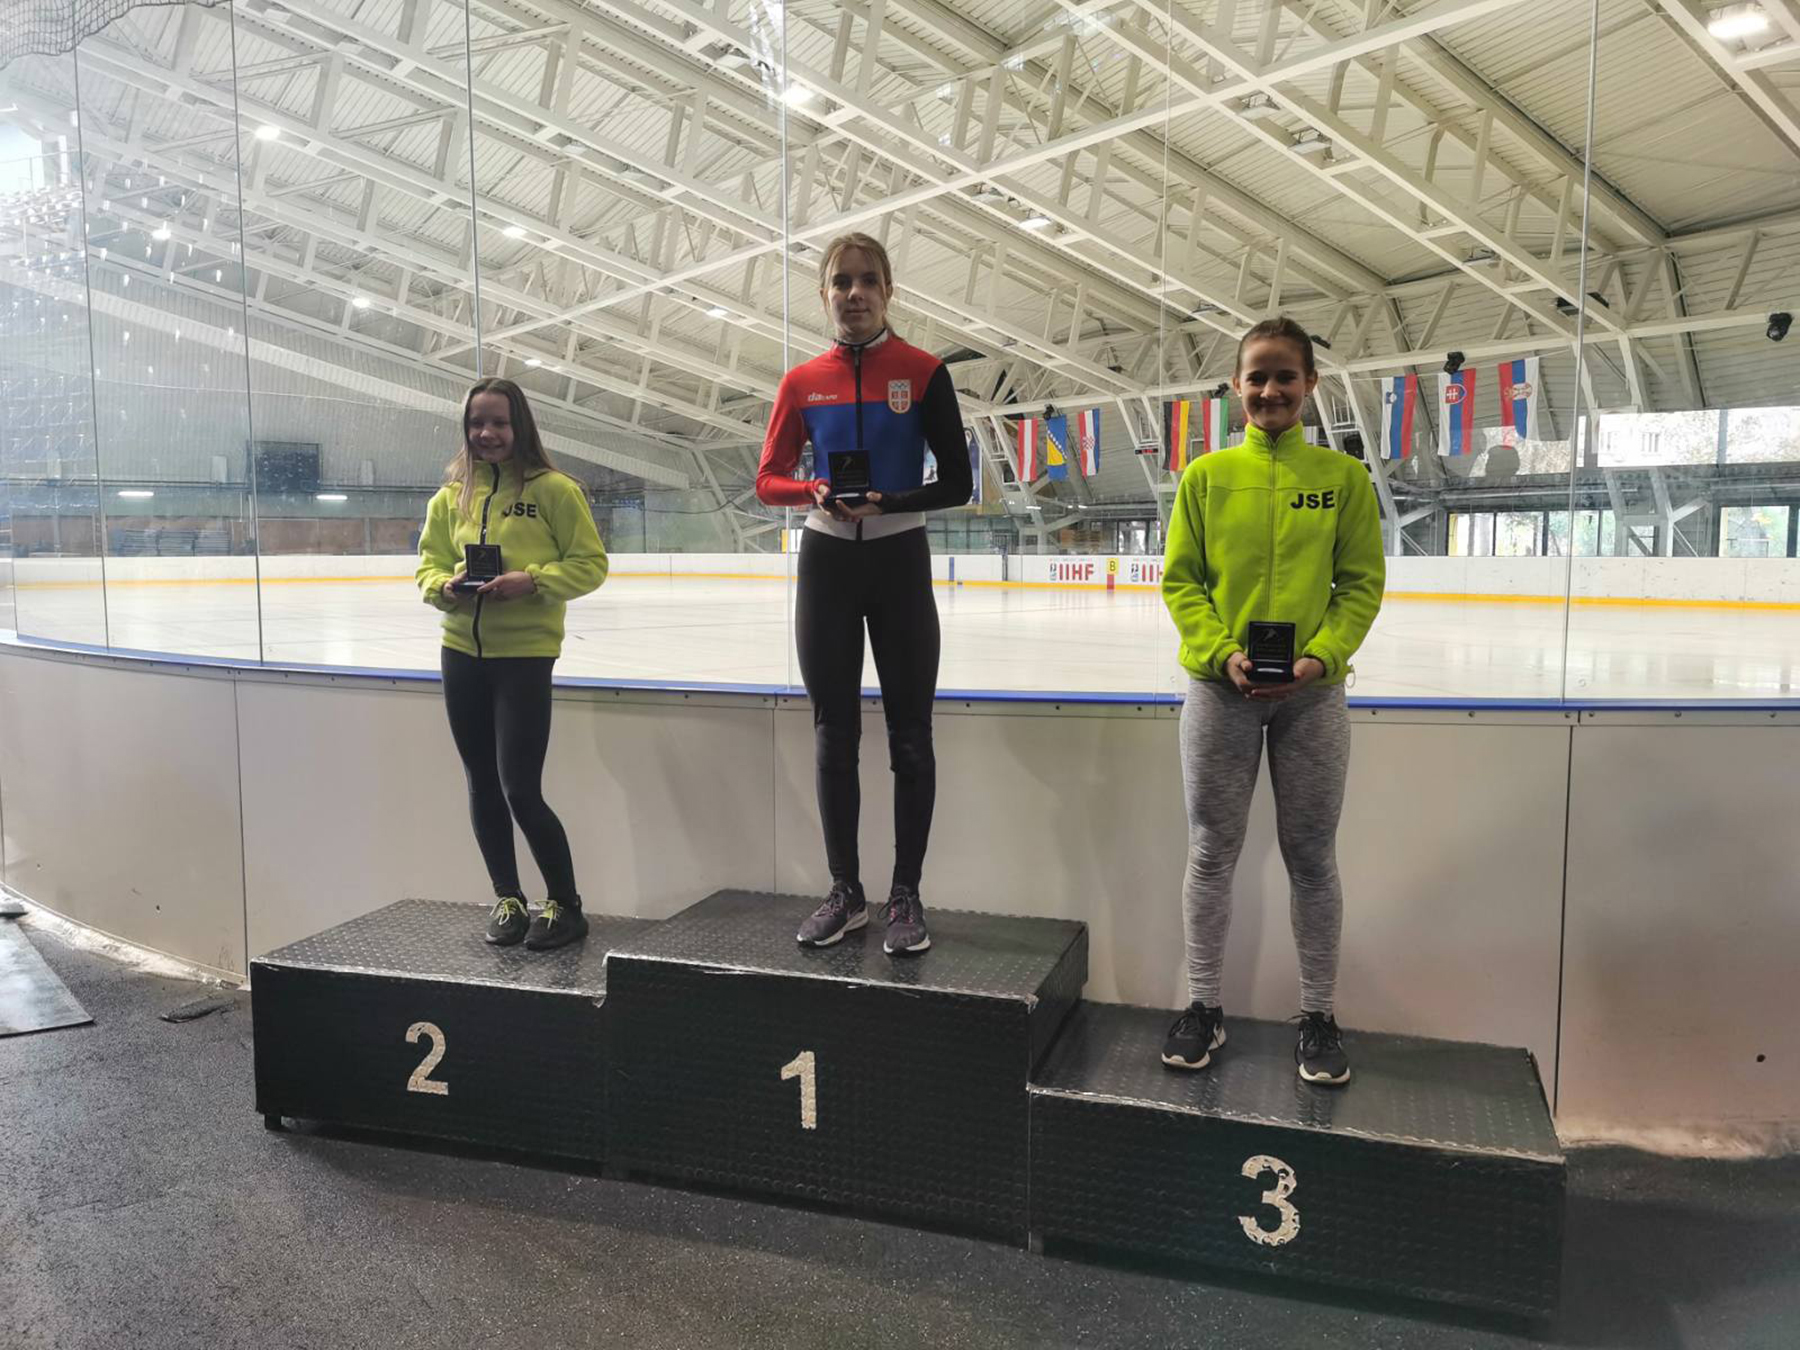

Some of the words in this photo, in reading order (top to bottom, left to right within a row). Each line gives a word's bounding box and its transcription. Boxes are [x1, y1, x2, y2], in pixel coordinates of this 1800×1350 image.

[501, 502, 538, 518] JSE
[1290, 490, 1336, 510] JSE
[1059, 563, 1094, 581] IIHF
[405, 1021, 449, 1096] 2
[780, 1050, 818, 1130] 1
[1238, 1154, 1301, 1247] 3
